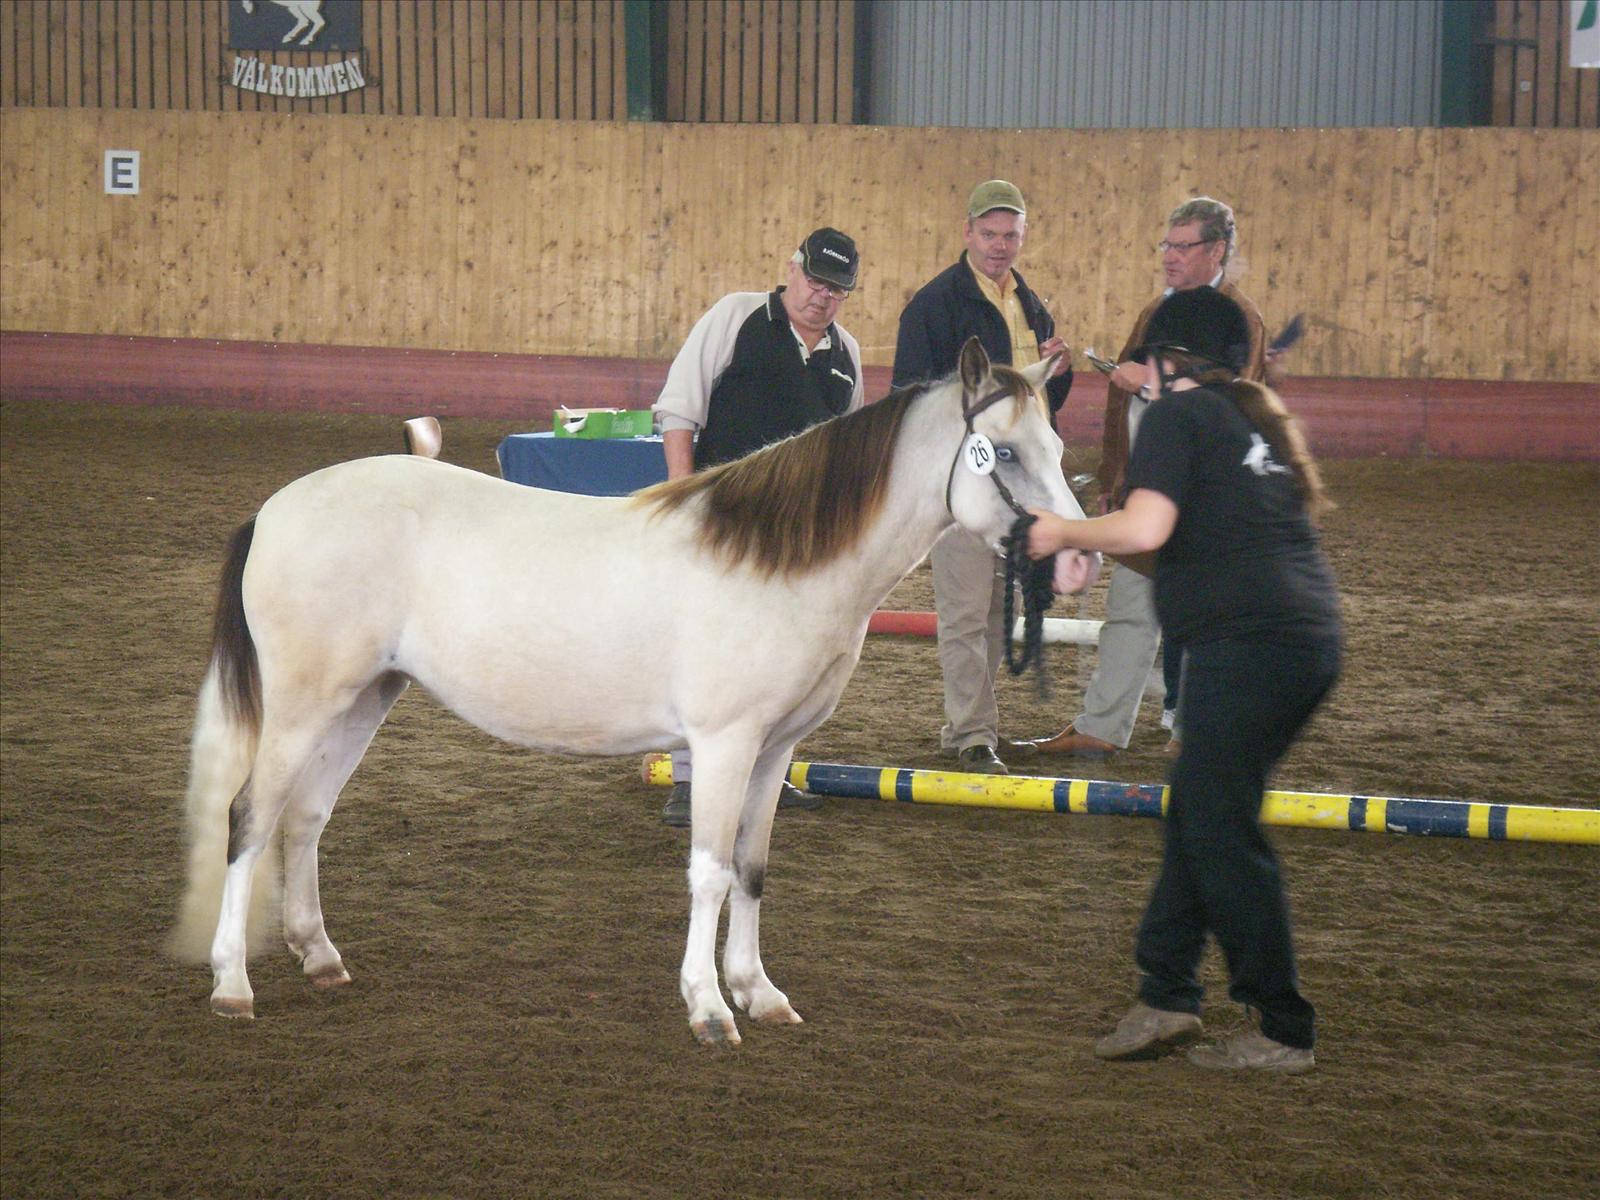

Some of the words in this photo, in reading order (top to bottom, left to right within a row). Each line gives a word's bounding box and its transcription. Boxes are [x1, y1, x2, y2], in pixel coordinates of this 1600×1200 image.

[232, 56, 365, 97] VÄLKOMMEN
[112, 157, 133, 188] E
[970, 440, 989, 468] 26
